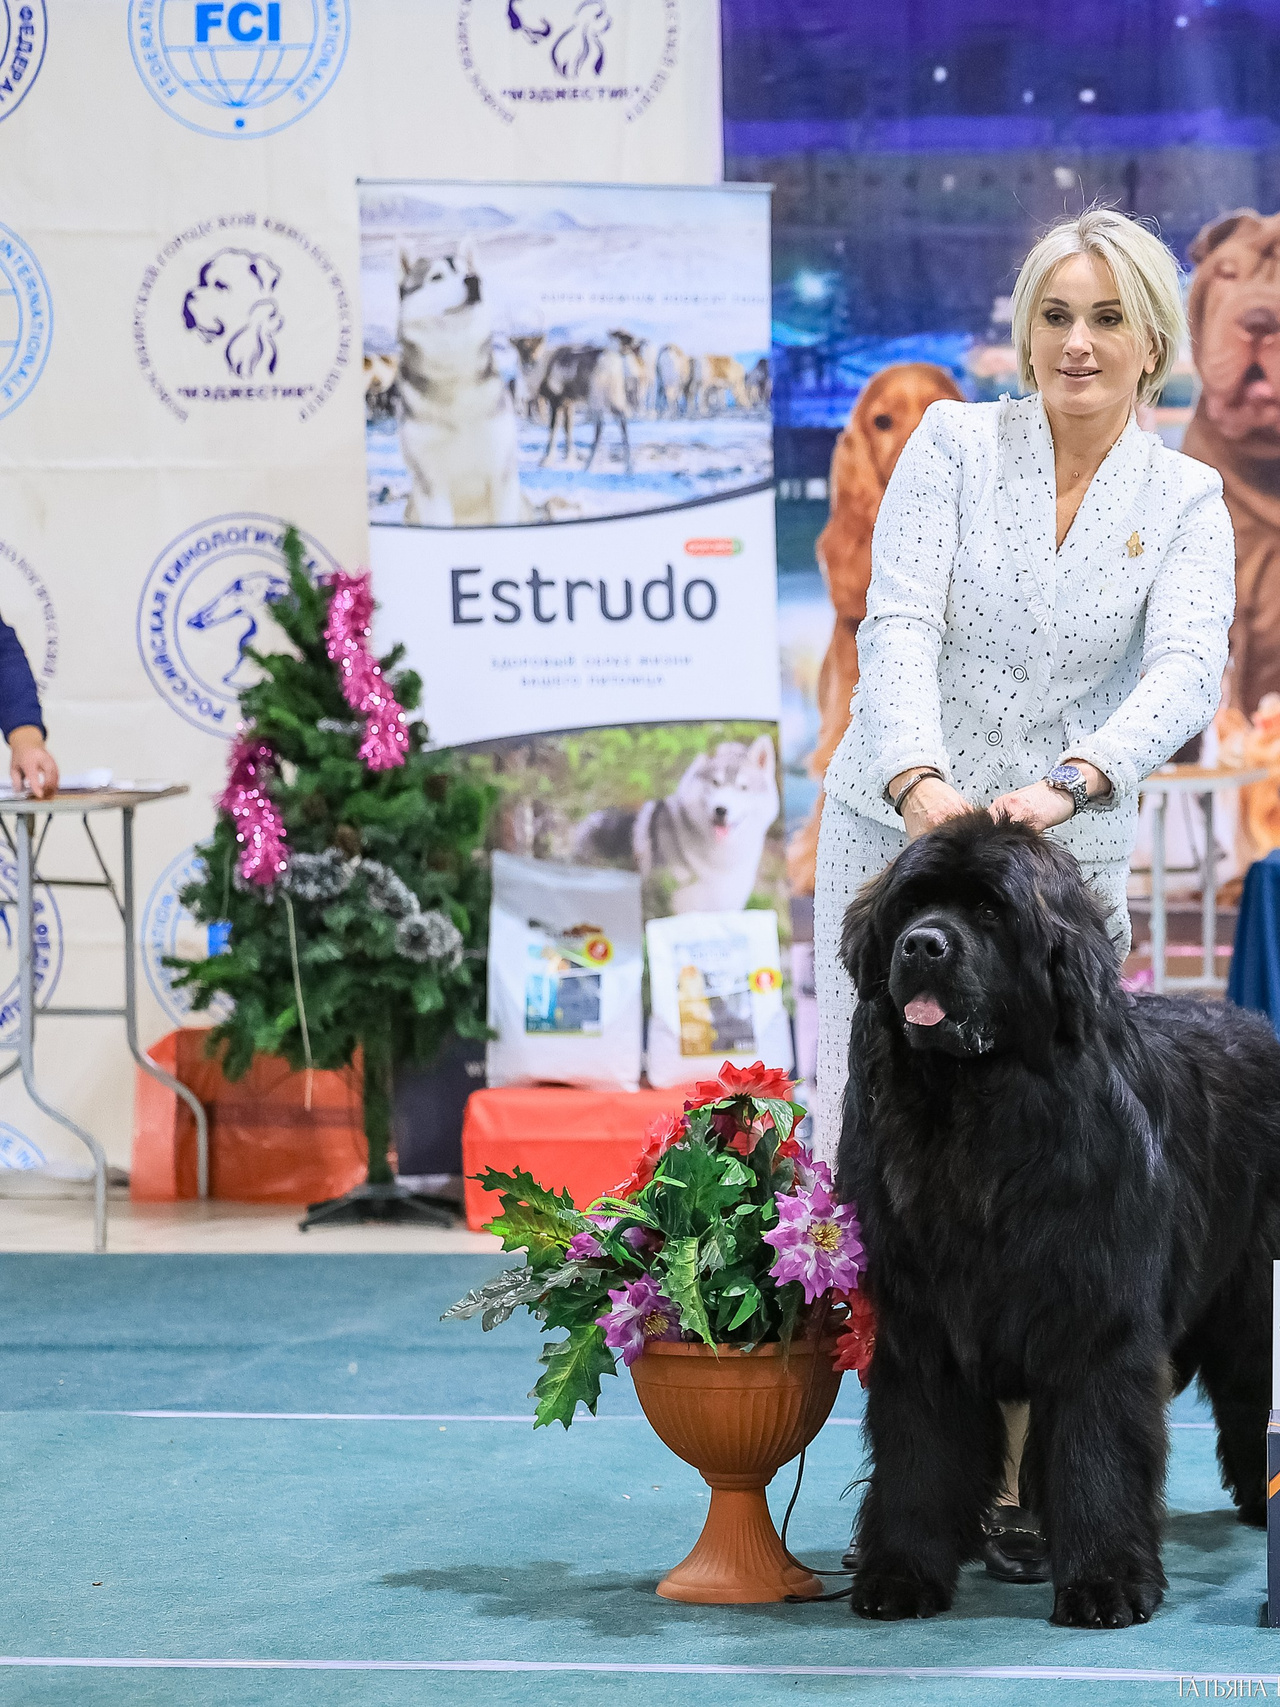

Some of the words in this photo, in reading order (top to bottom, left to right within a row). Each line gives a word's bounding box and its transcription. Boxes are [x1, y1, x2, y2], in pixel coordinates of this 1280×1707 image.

[0, 5, 35, 101] ФЕДЕРА
[196, 2, 280, 43] FCI
[451, 565, 717, 626] Estrudo
